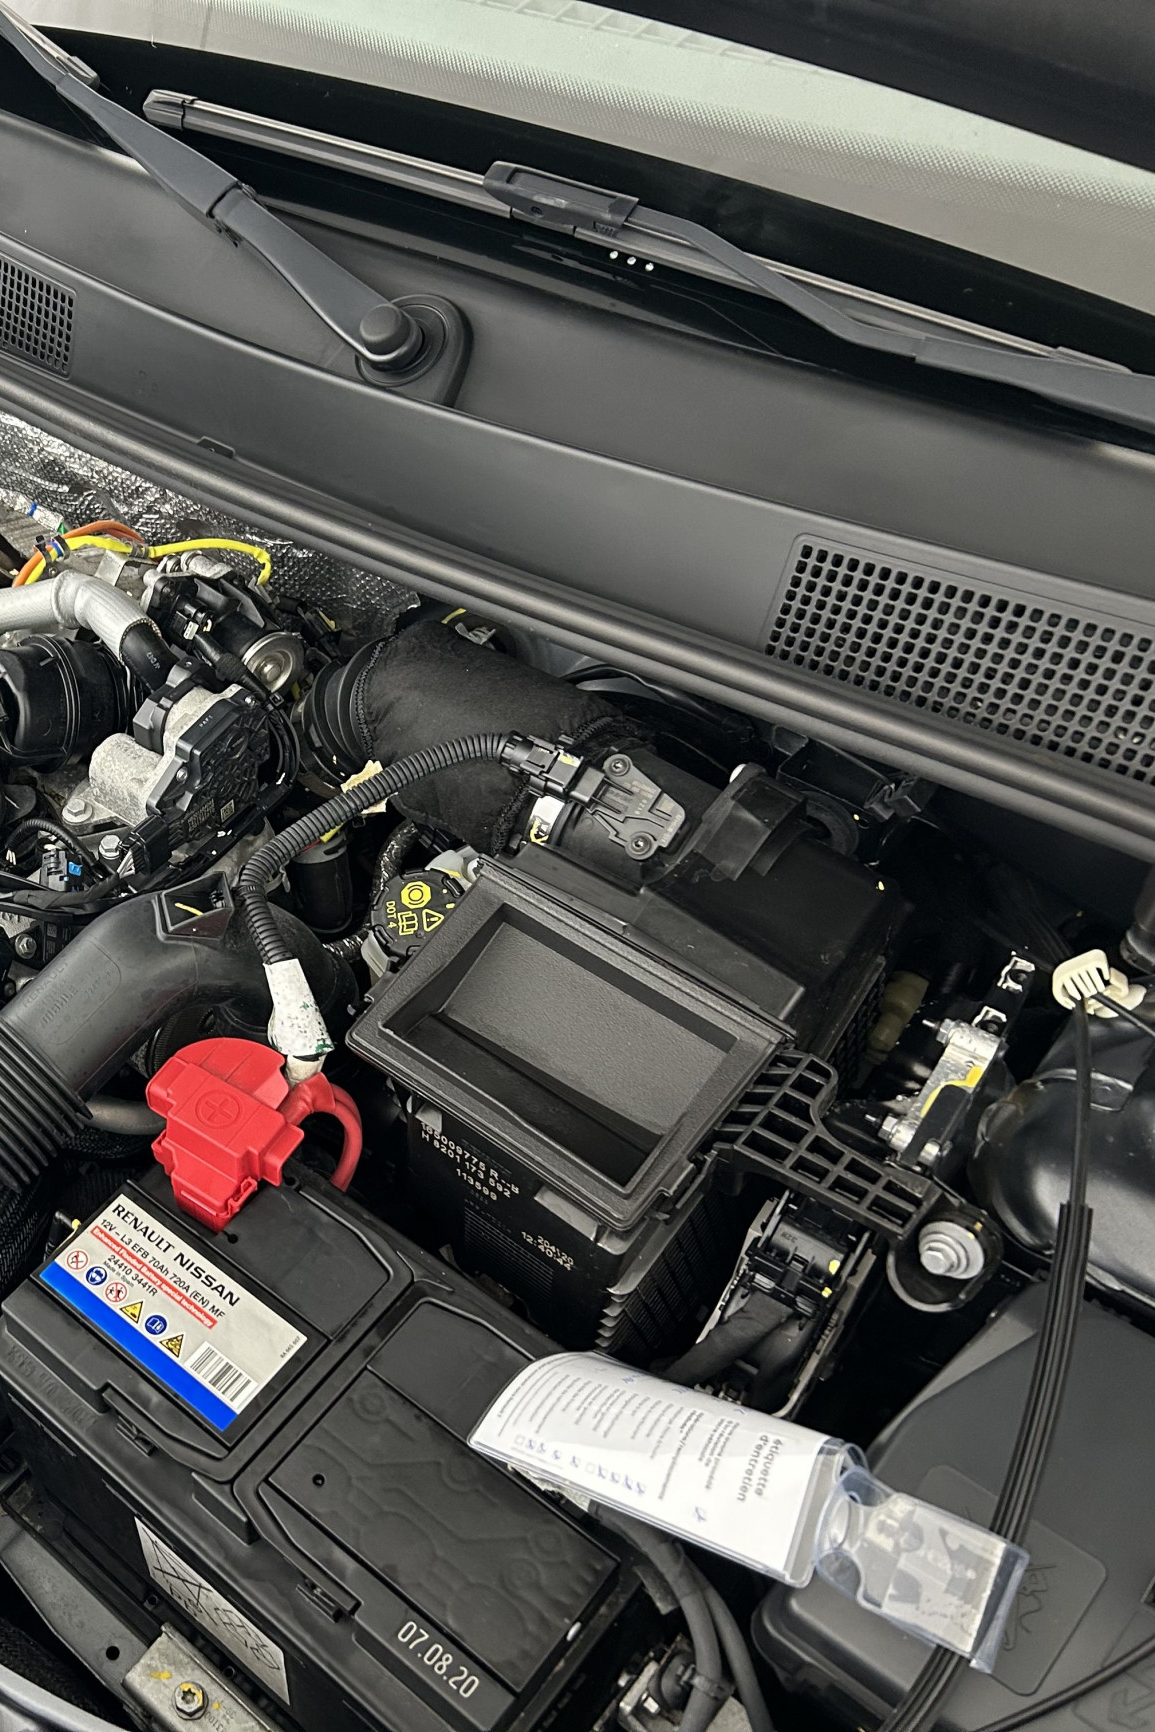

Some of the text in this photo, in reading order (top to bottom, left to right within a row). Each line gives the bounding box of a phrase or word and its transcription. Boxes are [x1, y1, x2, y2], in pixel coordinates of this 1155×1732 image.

[386, 901, 396, 919] DOT
[92, 1226, 214, 1328] Enhanced Flooded Battery special technology
[100, 1218, 116, 1233] 12V
[119, 1233, 133, 1246] L3
[130, 1242, 149, 1259] EFB
[147, 1255, 170, 1276] 70Ah
[168, 1272, 191, 1293] 720A
[188, 1289, 210, 1308] (EN)
[207, 1304, 225, 1320] MF
[107, 1253, 158, 1296] 24410 3441R
[111, 1203, 240, 1306] RENAULT NISSAN
[754, 1438, 782, 1496] étiquette
[397, 1620, 480, 1699] 07.08.20
